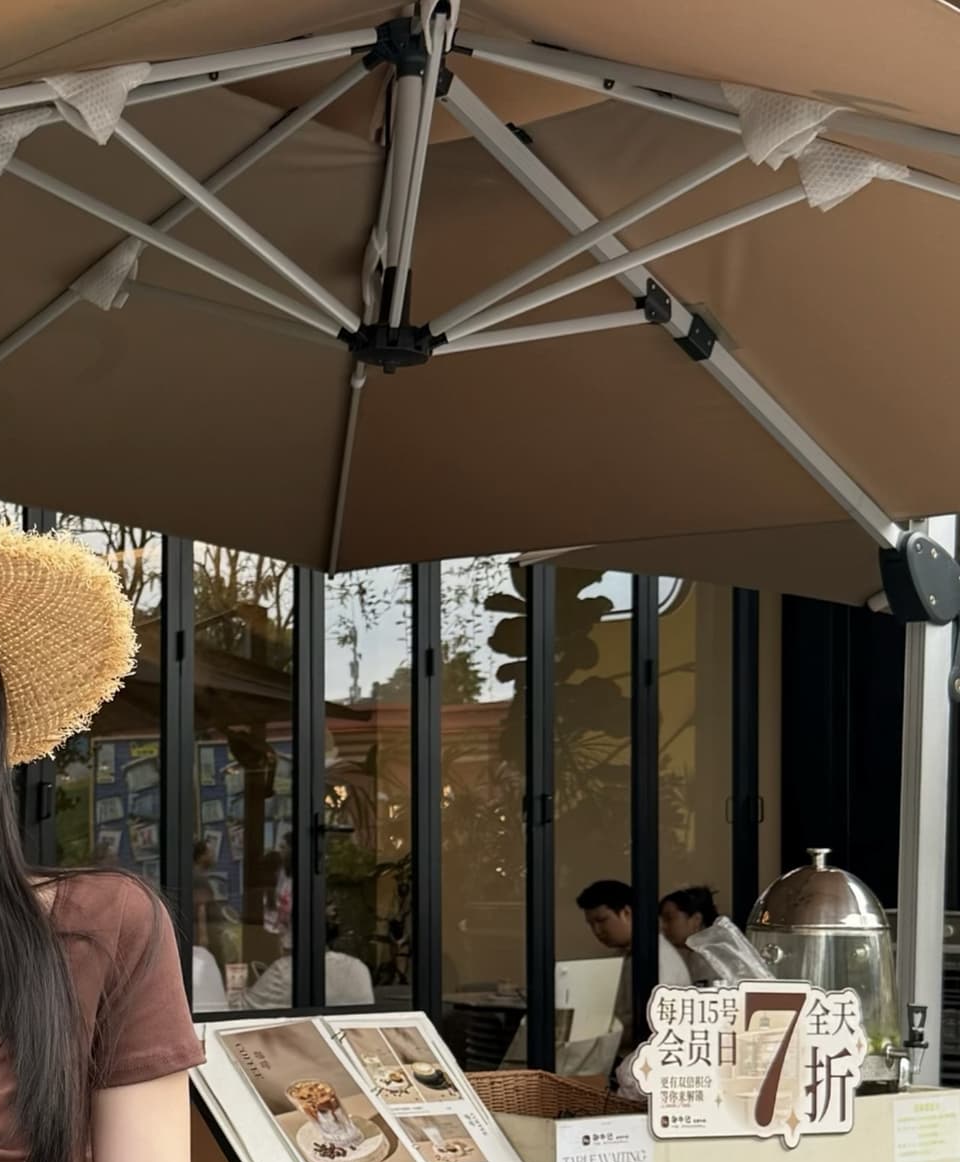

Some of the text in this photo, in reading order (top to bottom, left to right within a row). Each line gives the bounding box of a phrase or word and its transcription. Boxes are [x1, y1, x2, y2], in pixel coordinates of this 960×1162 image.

[656, 997, 739, 1026] 每月15号
[806, 998, 855, 1037] 全天
[656, 1028, 737, 1067] 会员日
[744, 992, 854, 1127] 7 折
